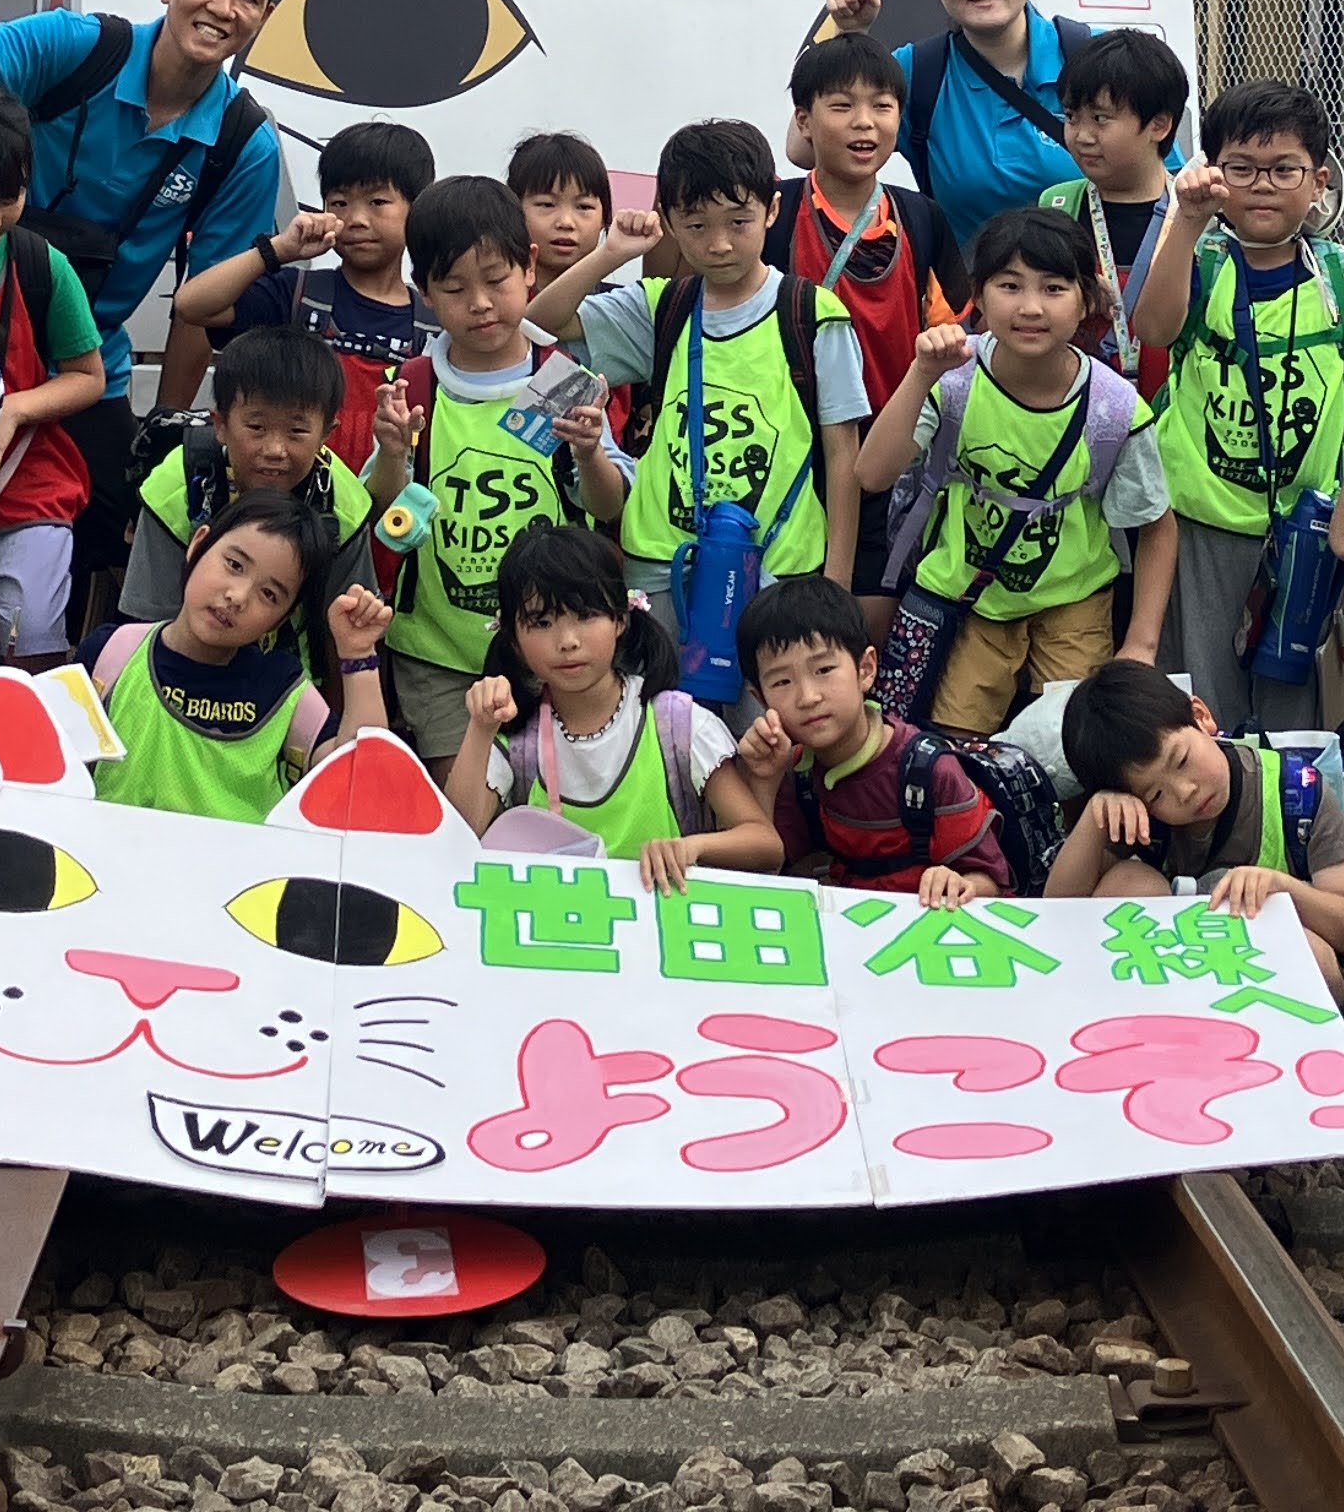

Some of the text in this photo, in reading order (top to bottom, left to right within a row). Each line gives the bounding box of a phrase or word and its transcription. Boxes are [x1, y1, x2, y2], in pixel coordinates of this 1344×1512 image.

[169, 172, 195, 192] SS
[667, 443, 726, 475] KIS
[445, 469, 539, 521] TSS
[440, 518, 510, 553] KIDS
[185, 697, 256, 723] BOARDS
[182, 1111, 427, 1165] Welcome
